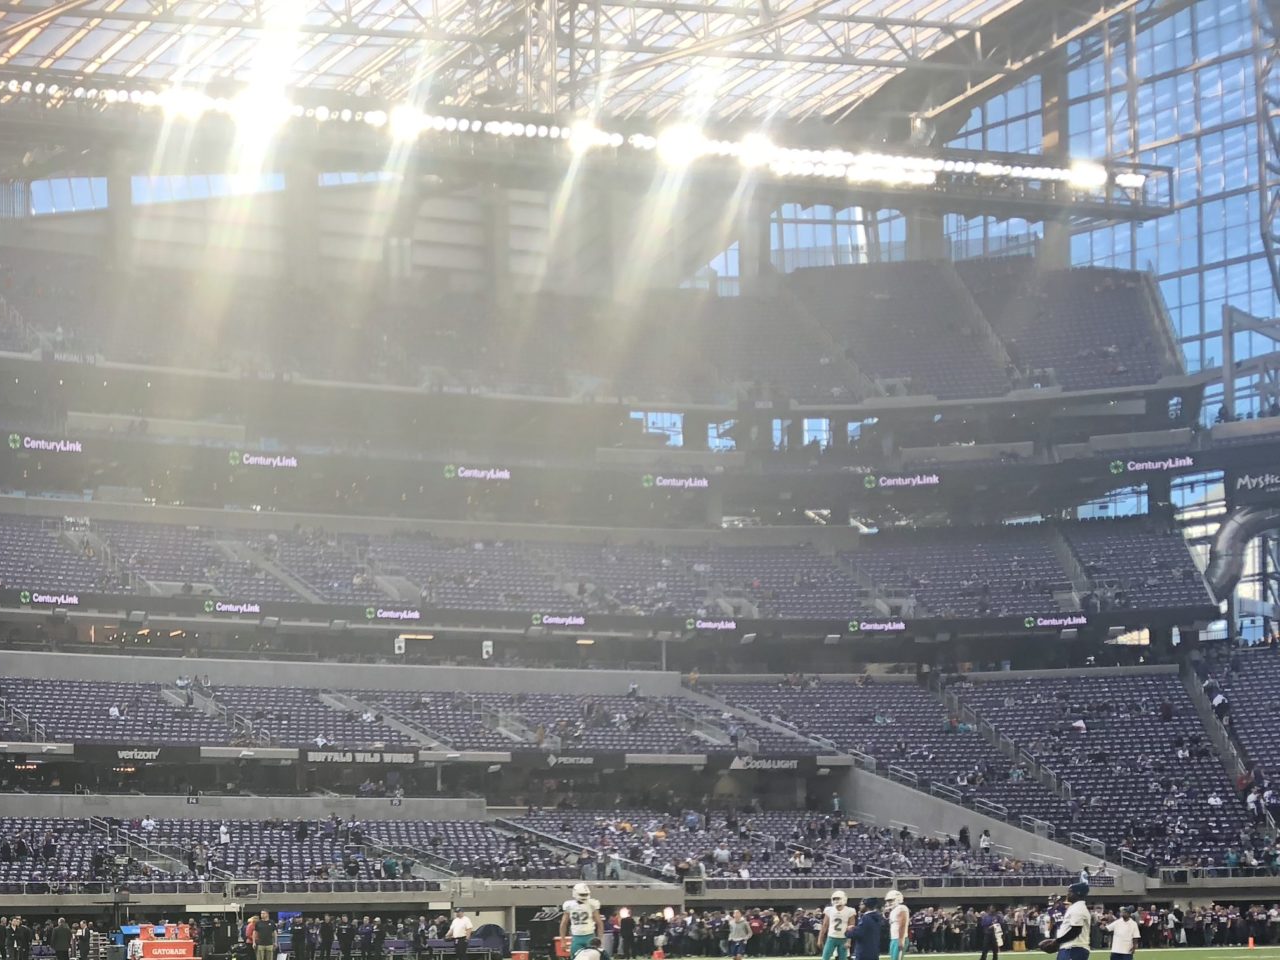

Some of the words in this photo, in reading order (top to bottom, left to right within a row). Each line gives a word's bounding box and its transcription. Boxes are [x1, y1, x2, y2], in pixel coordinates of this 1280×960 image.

[23, 436, 82, 453] CenturyLink
[242, 453, 298, 467] CenturyLink
[1127, 457, 1194, 471] CenturyLink
[457, 466, 511, 480] CenturyLink
[655, 476, 709, 489] CenturyLink
[878, 474, 940, 487] CenturyLink
[32, 593, 79, 606] CenturyLink
[215, 601, 260, 613] CenturyLink
[376, 608, 420, 620] CenturyLink
[542, 614, 585, 626] CenturyLink
[1037, 615, 1087, 626] CenturyLink
[696, 619, 737, 630] CenturyLink
[859, 621, 906, 631] CenturyLink
[117, 749, 157, 760] verizon
[307, 751, 352, 763] BUFFALO
[355, 752, 380, 763] WILD
[382, 752, 415, 764] WINGS
[571, 911, 588, 925] 92
[833, 918, 842, 931] 2
